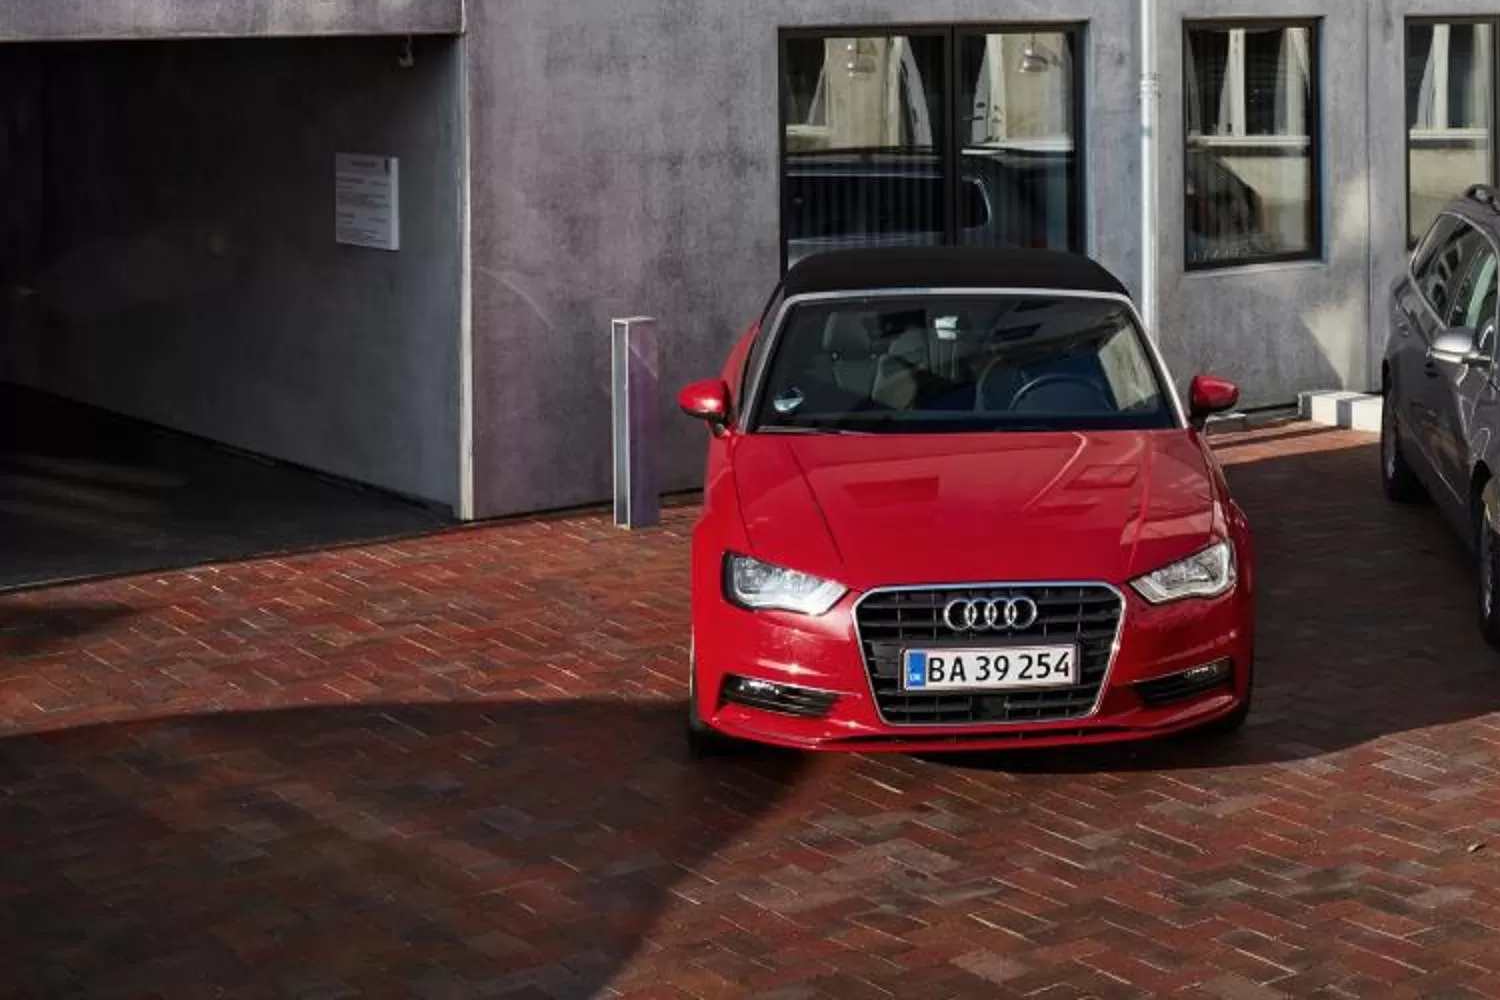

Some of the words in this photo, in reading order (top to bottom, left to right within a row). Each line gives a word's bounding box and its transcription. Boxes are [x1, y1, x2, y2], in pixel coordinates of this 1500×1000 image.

[928, 656, 967, 682] BA
[975, 654, 1009, 681] 39
[1017, 651, 1070, 679] 254
